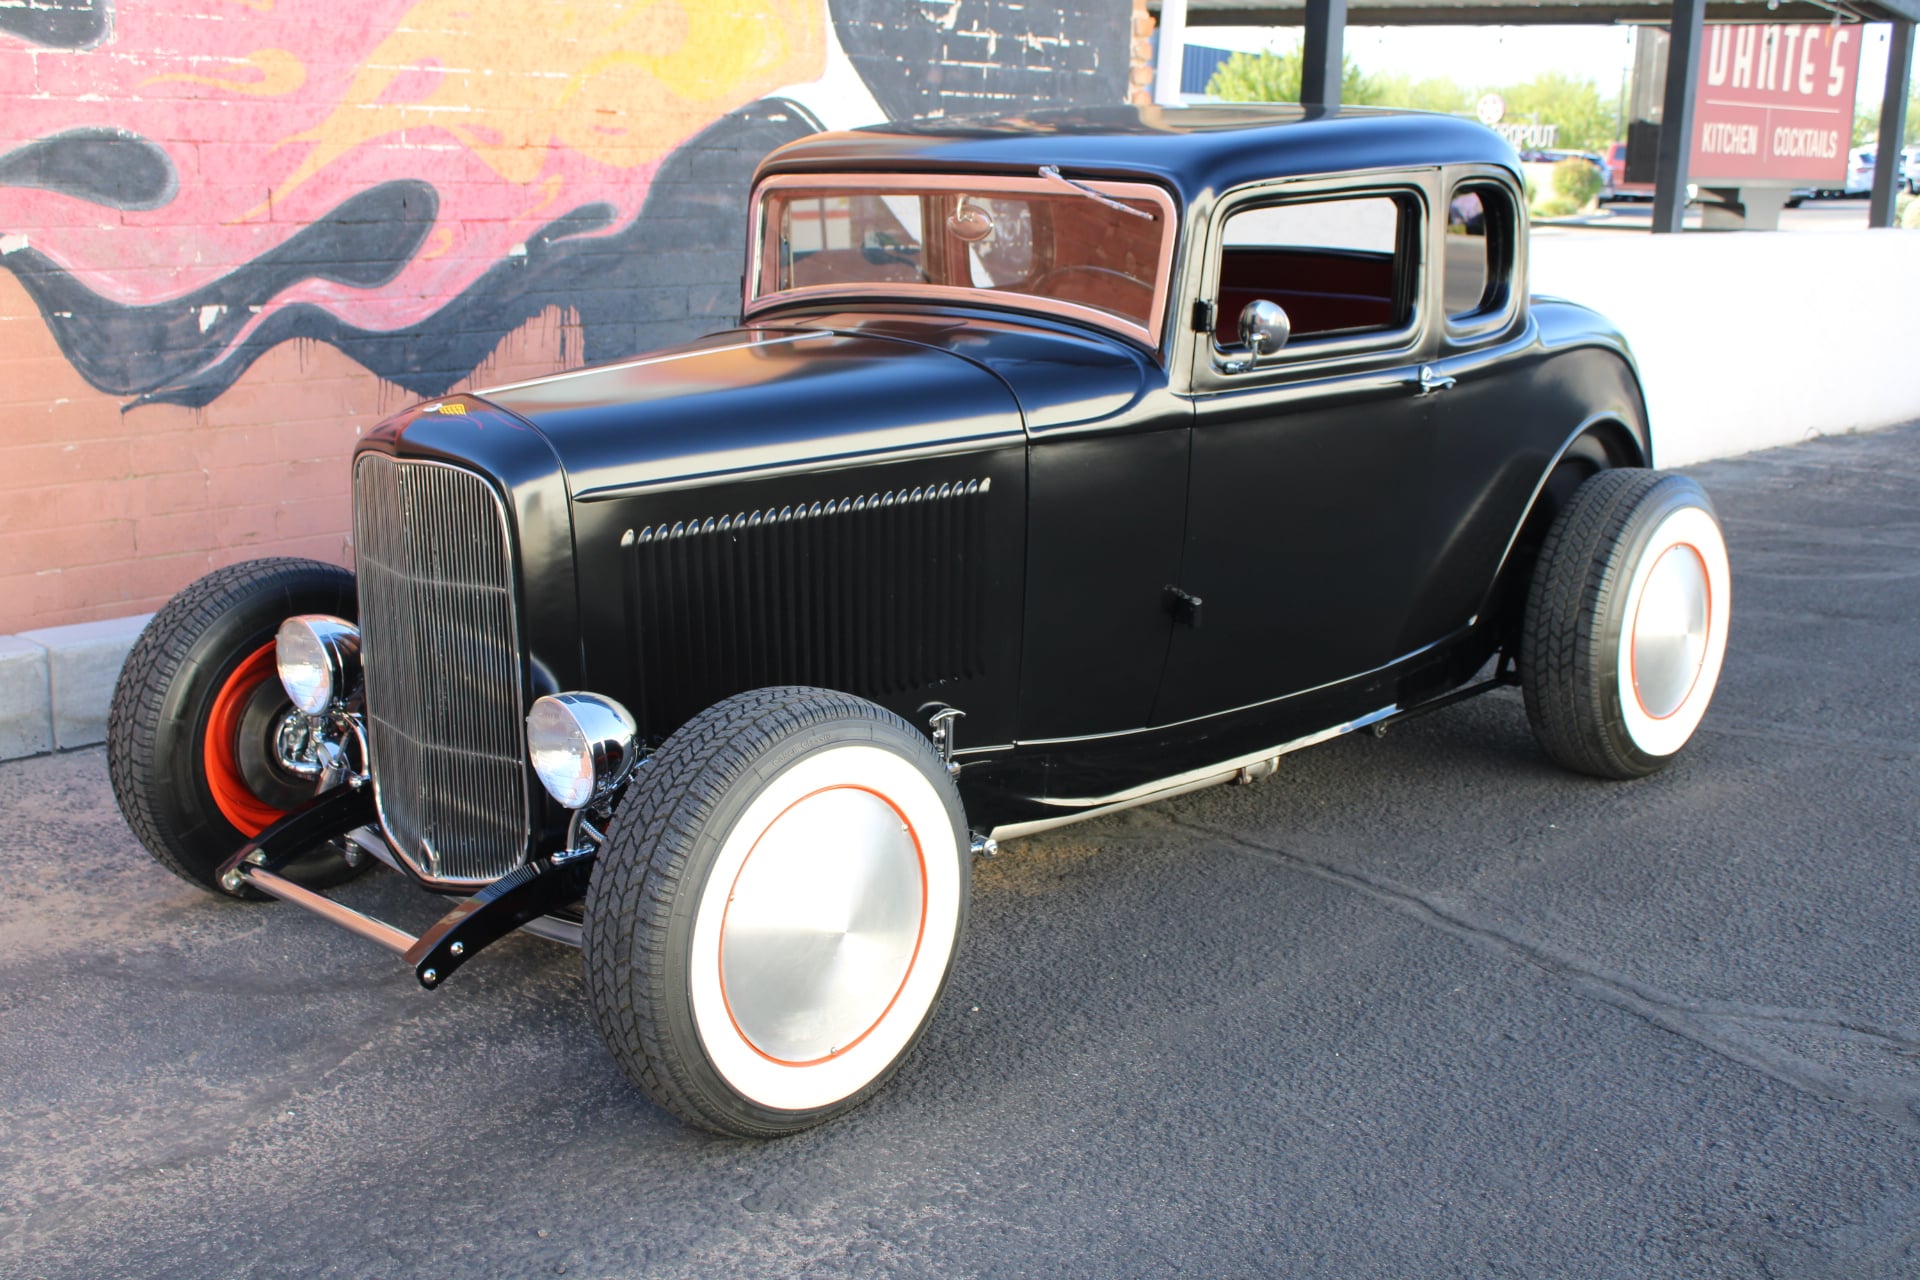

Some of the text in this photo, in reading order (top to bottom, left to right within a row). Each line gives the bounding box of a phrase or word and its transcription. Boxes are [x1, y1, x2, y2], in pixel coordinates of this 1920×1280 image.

[1493, 124, 1558, 150] ROPOUT
[1701, 122, 1839, 159] KITCHEN COCKTAILS
